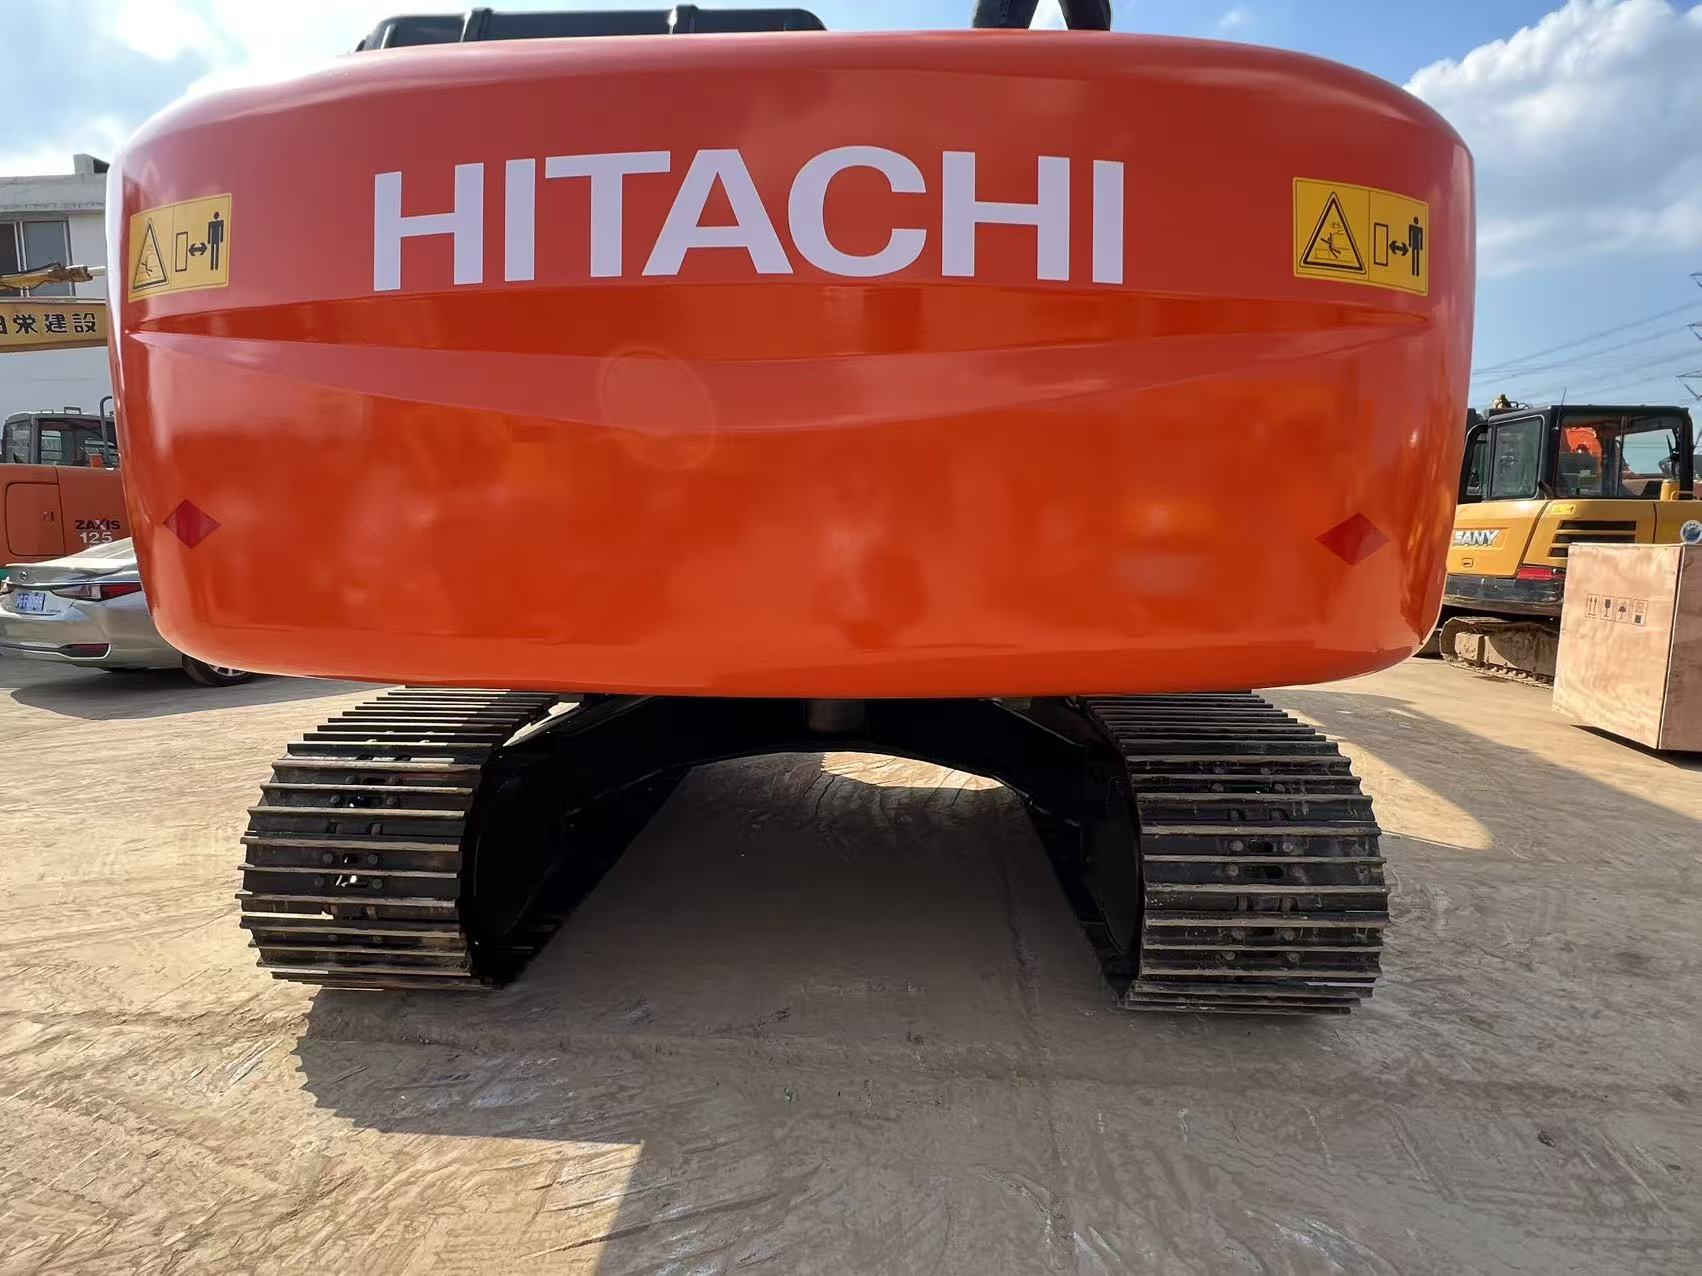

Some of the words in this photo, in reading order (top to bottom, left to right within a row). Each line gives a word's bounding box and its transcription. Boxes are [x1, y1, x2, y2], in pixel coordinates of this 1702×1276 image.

[373, 145, 1124, 292] HITACHI
[75, 519, 121, 530] ZAXIS
[79, 531, 113, 544] 125
[1453, 529, 1500, 545] SANY
